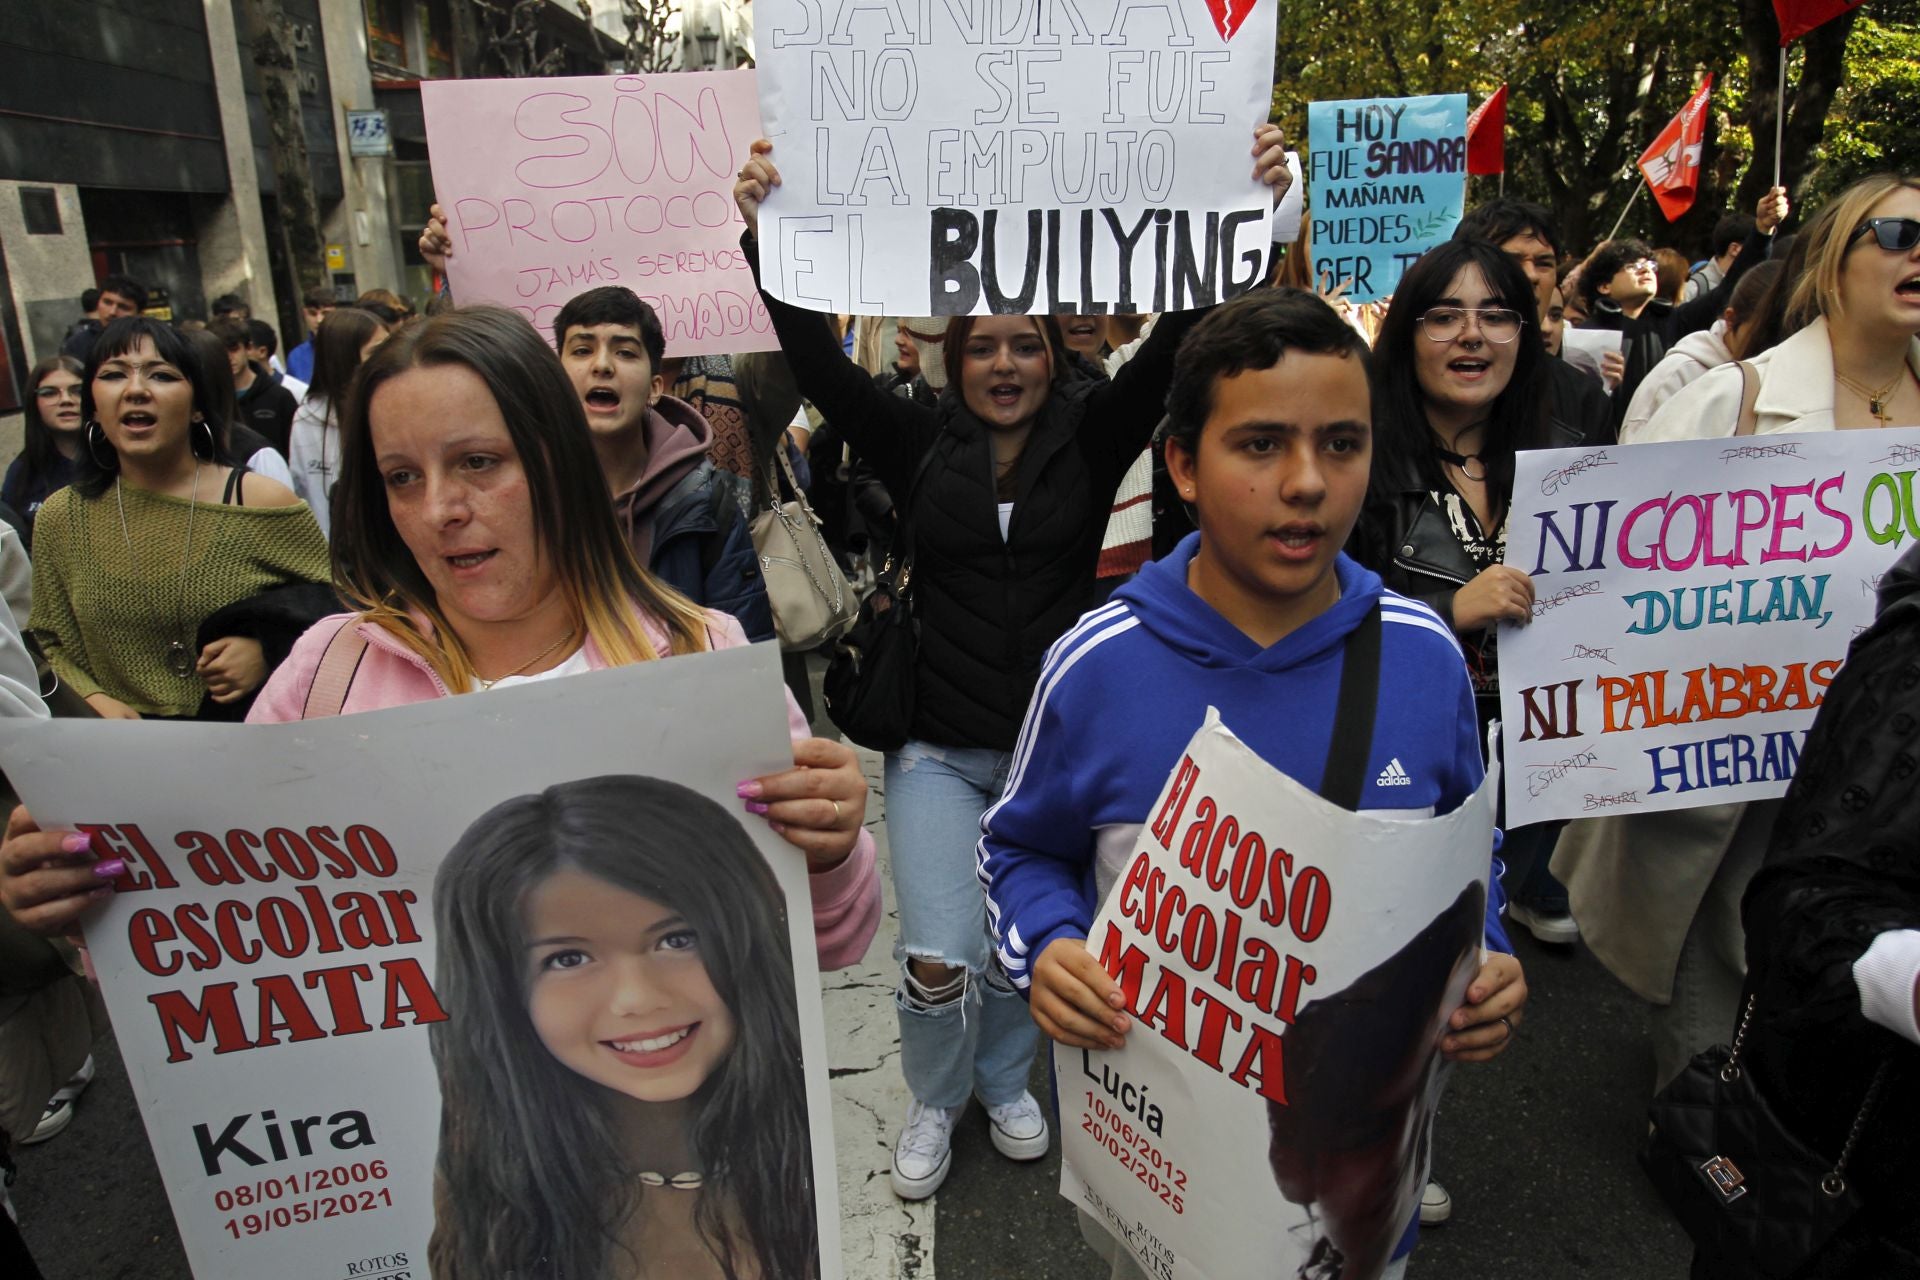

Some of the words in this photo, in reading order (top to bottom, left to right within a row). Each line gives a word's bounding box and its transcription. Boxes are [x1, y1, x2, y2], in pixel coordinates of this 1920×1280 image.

[773, 0, 1194, 48] SANDRA
[811, 49, 918, 121] NO
[975, 51, 1061, 125] SE
[1103, 50, 1231, 124] FUE
[1336, 104, 1407, 143] HOY
[815, 127, 910, 206] LA
[927, 129, 1175, 206] EMPUJO
[1311, 147, 1359, 182] FUE
[1364, 136, 1467, 179] SANDRA
[1325, 182, 1426, 209] MAÑANA
[637, 249, 750, 277] SEREMOS
[1312, 214, 1411, 246] PUEDES
[779, 213, 884, 317] EL
[1316, 255, 1375, 296] SER
[1528, 500, 1619, 577] NI
[1616, 471, 1853, 572] GOLPES
[1622, 573, 1833, 635] DUELAN,
[1518, 679, 1584, 742] NI
[1597, 659, 1844, 734] PALABRAS
[1376, 775, 1411, 787] adidas
[1643, 729, 1812, 795] HIERAN
[74, 823, 180, 893] El
[174, 824, 398, 886] acoso
[1151, 754, 1200, 852] El
[1179, 795, 1331, 943] acoso
[128, 885, 422, 977] escolar
[1120, 851, 1317, 1026] escolar
[147, 958, 450, 1063] MATA
[1099, 919, 1289, 1107] MATA
[1082, 1047, 1164, 1139] Lucía
[192, 1109, 376, 1177] Kira
[1082, 1112, 1185, 1215] 20/02/2025
[1086, 1090, 1188, 1192] 10/06/2012
[214, 1159, 388, 1212] 08/01/2006
[223, 1187, 393, 1240] 19/05/2021
[346, 1251, 409, 1275] ROTOS
[1137, 1221, 1175, 1265] ROTOS
